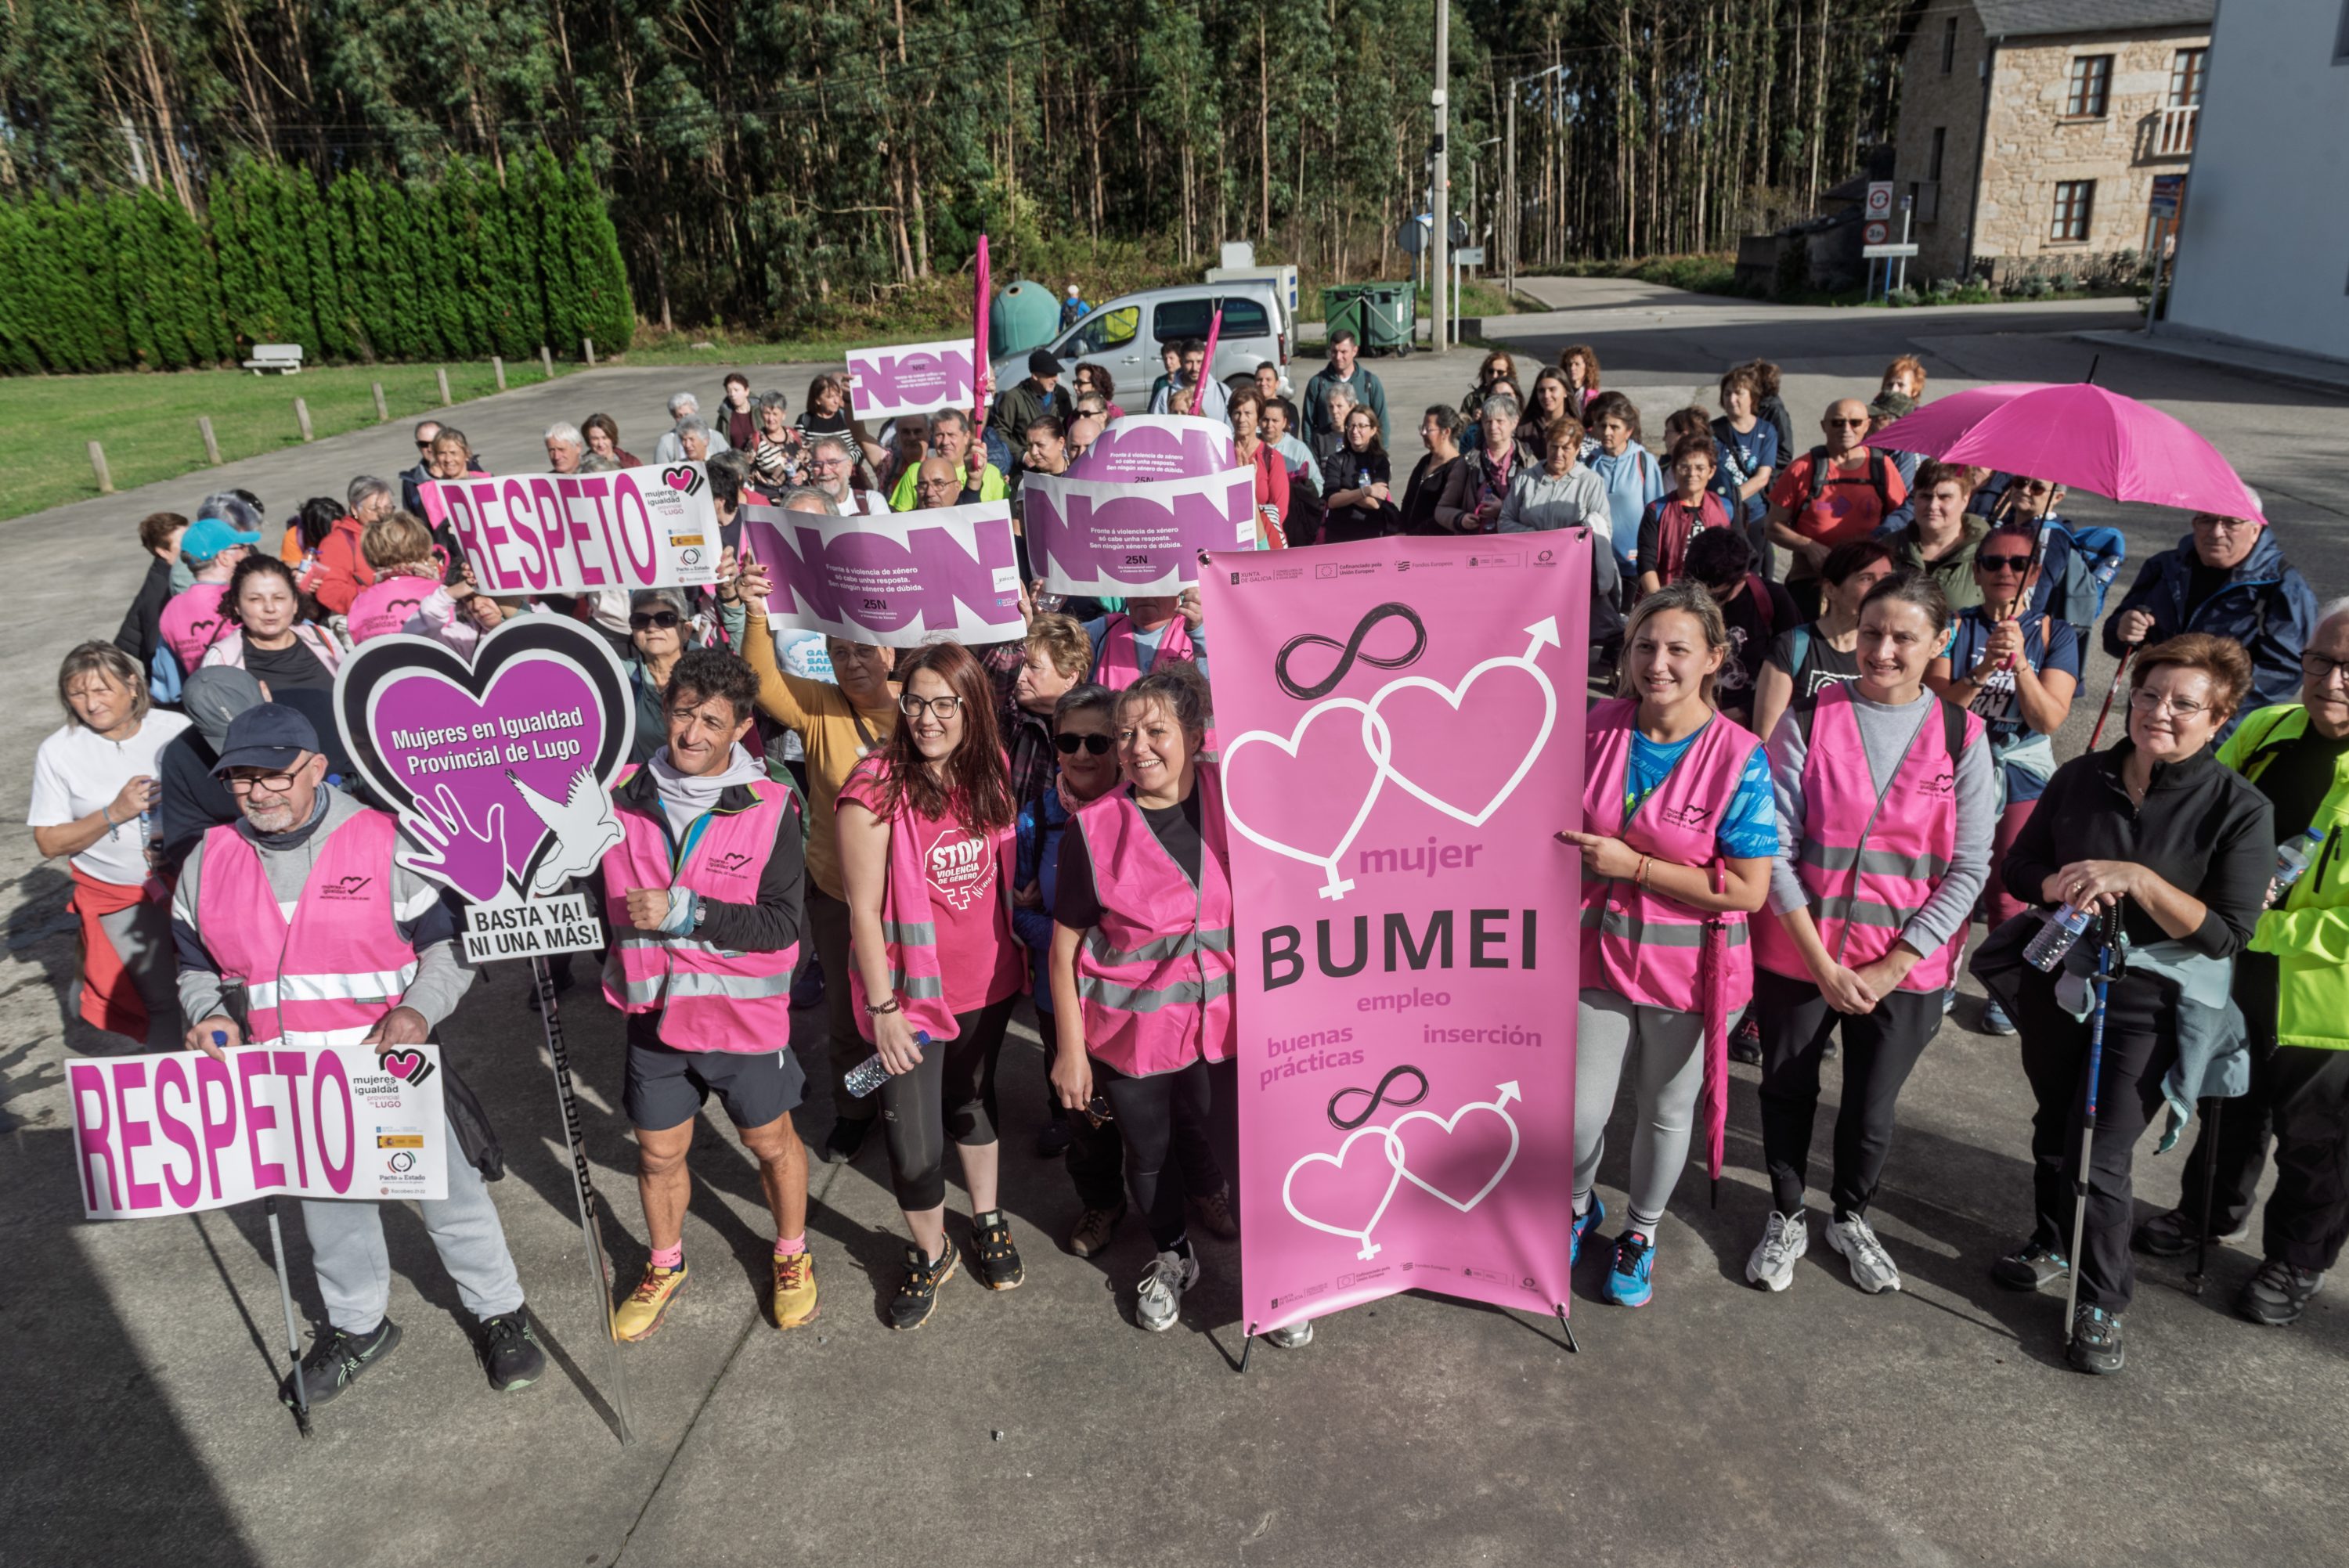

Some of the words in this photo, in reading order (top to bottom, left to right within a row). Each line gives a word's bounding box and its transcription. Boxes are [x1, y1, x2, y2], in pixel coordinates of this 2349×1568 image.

[644, 489, 677, 499] mujeres
[648, 497, 680, 506] igualdad
[441, 473, 656, 591] RESPETO
[1024, 480, 1254, 585] NON
[825, 564, 845, 573] Fronte
[892, 567, 918, 575] xénero
[1125, 555, 1148, 564] 25N
[745, 517, 1023, 633] NON
[840, 582, 861, 592] ningún
[843, 575, 858, 583] cabe
[876, 576, 911, 586] resposta.
[863, 599, 887, 610] 25N
[391, 726, 469, 752] Mujeres
[471, 720, 496, 740] en
[498, 706, 584, 739] Igualdad
[406, 744, 502, 776] Provincial
[505, 742, 529, 764] de
[532, 738, 581, 762] Lugo
[932, 838, 984, 871] STOP
[1359, 836, 1483, 878] mujer
[936, 862, 980, 878] VIOLENCIA
[949, 872, 978, 883] GÉNERO
[972, 885, 984, 899] Ni
[981, 877, 992, 889] una
[474, 906, 543, 932] BASTA
[546, 902, 583, 924] YA!
[467, 935, 492, 957] NI
[495, 931, 541, 953] UNA
[544, 921, 600, 949] MÁS!
[1261, 909, 1537, 993] BUMEI
[1356, 986, 1452, 1014] empleo
[1267, 1026, 1354, 1058] buenas
[1423, 1024, 1542, 1047] inserción
[353, 1076, 396, 1086] mujeres
[547, 1013, 583, 1147] VIOLENCIA
[1260, 1048, 1365, 1090] prácticas
[355, 1085, 399, 1096] igualdad
[70, 1049, 355, 1210] RESPETO
[575, 1153, 594, 1220] STOP
